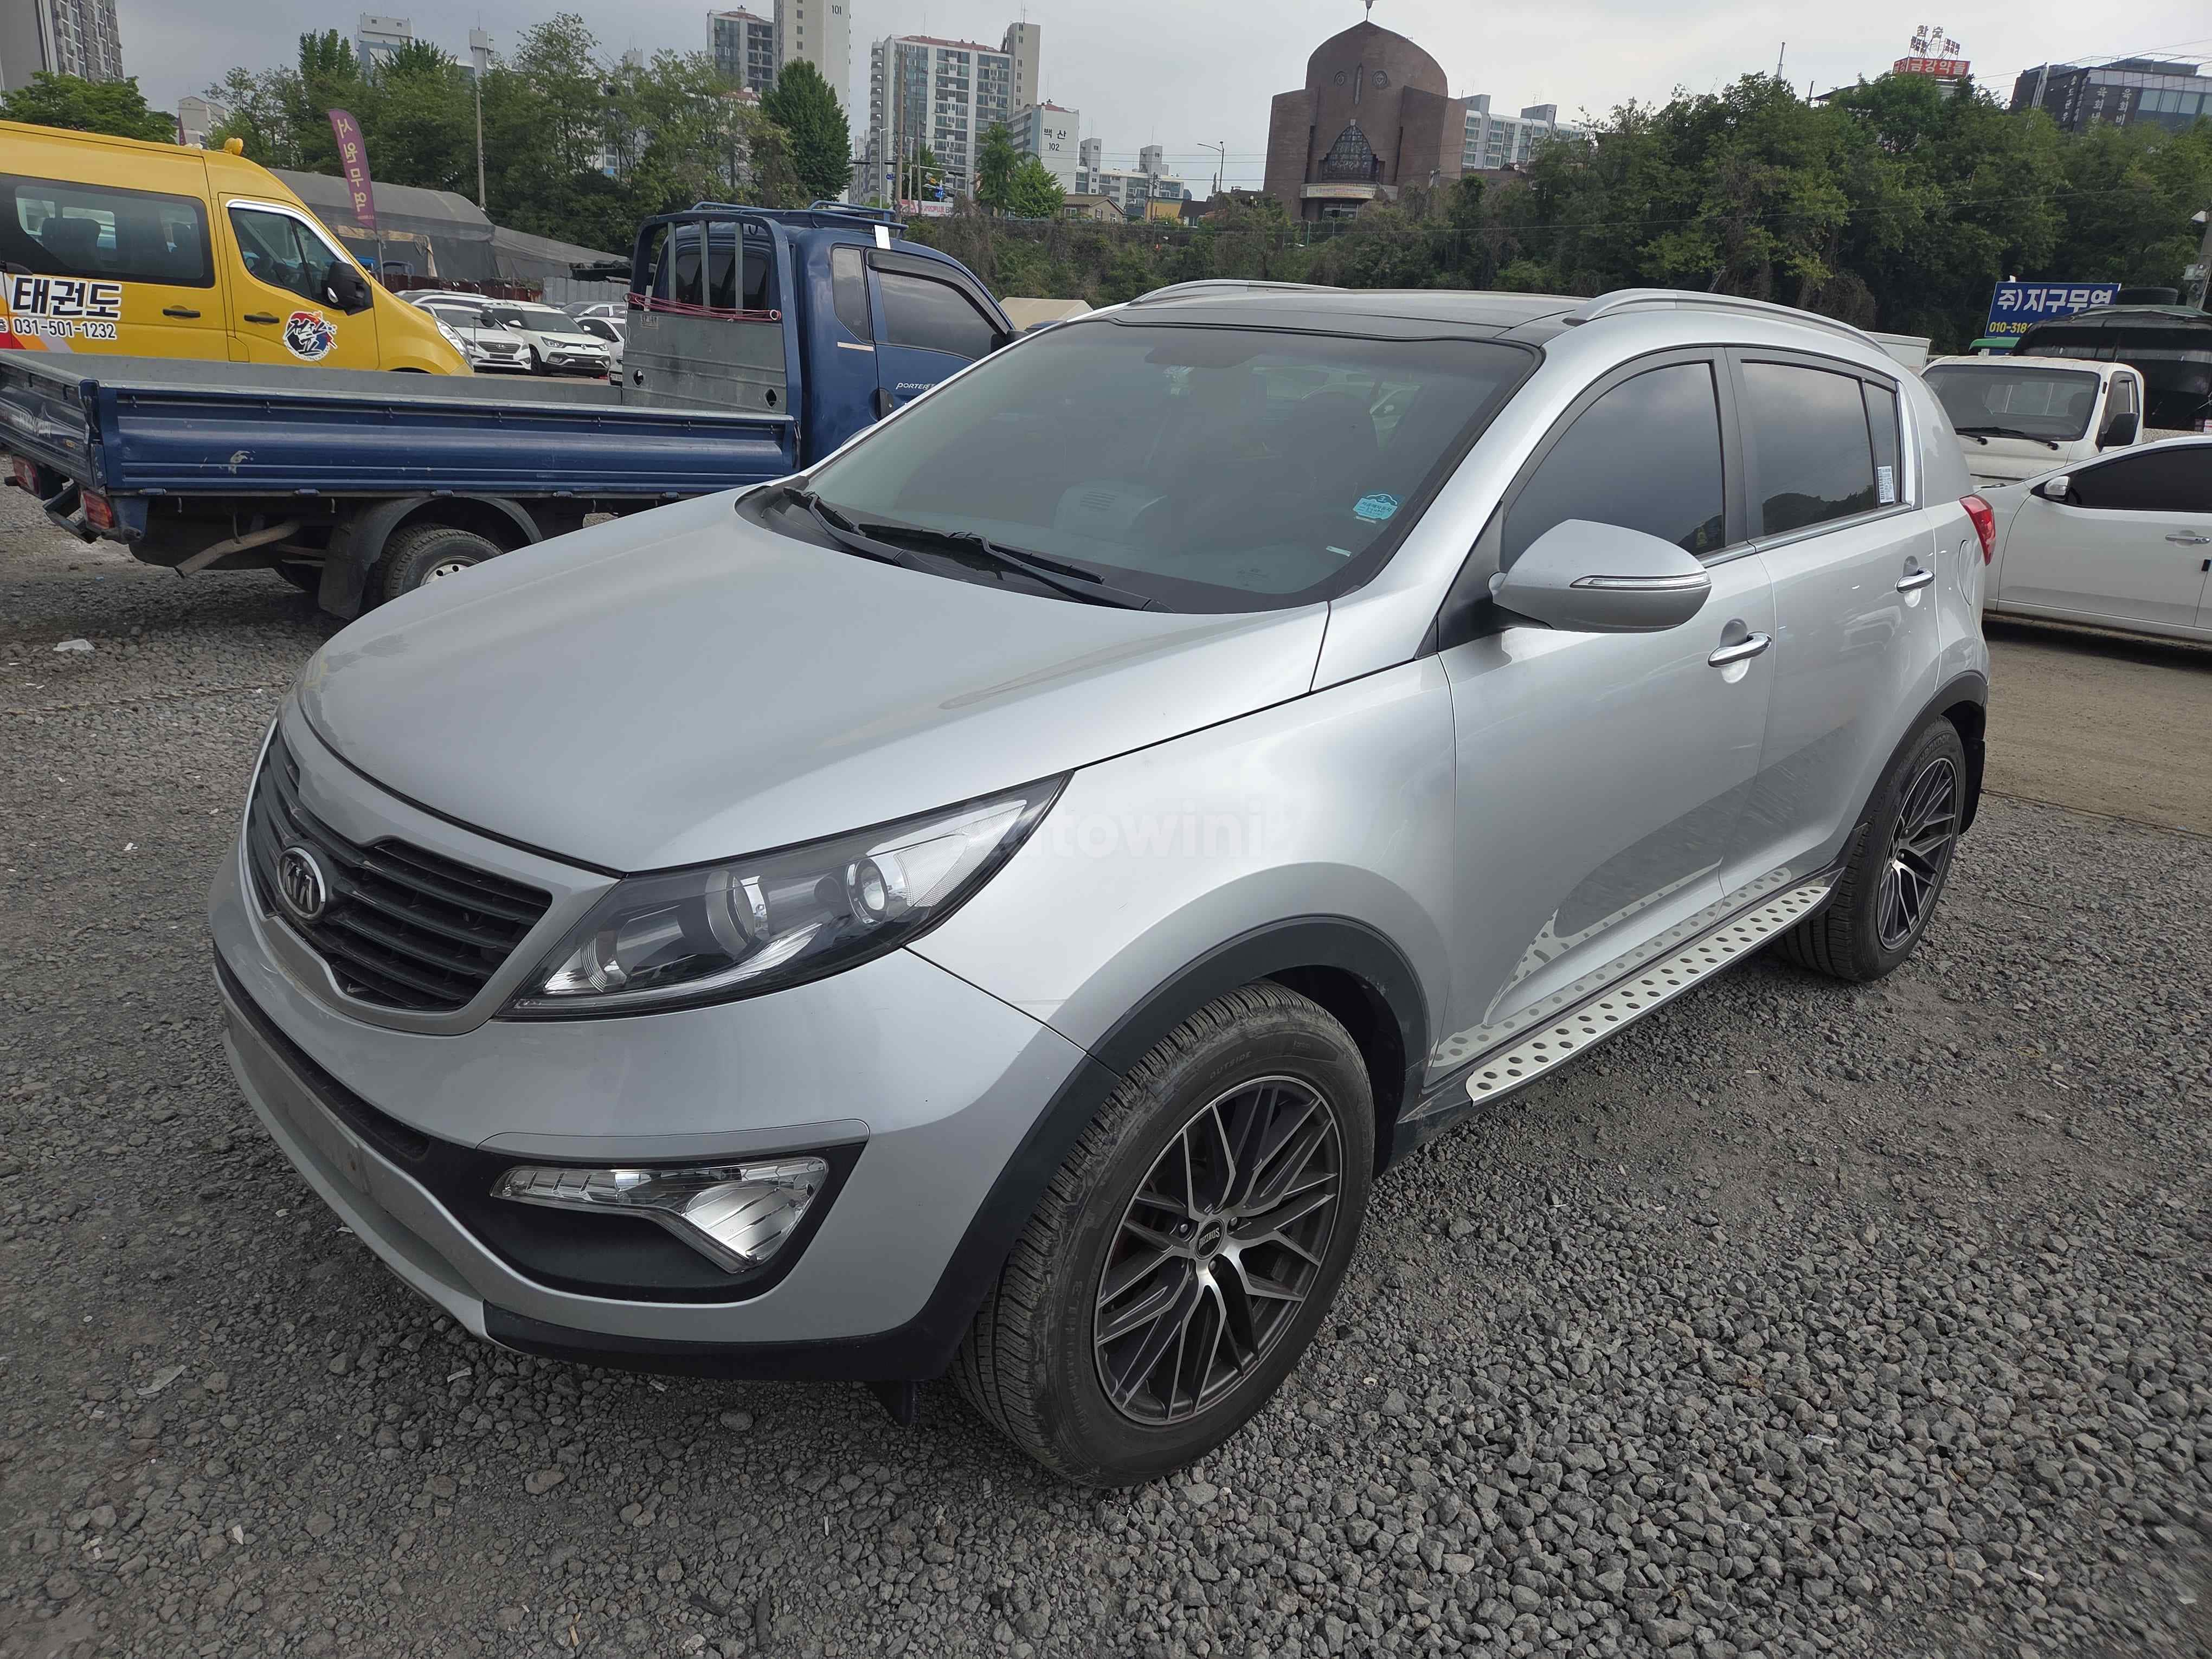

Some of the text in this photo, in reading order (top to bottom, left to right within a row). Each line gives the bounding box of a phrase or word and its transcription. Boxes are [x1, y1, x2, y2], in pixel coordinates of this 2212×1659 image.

[832, 4, 841, 15] 101
[1049, 142, 1060, 151] 102
[12, 276, 120, 318] 태권도
[14, 318, 115, 338] 031-501-1232
[1989, 322, 2033, 333] 010-318
[896, 382, 929, 390] PORTER
[1210, 1050, 1252, 1079] OUTSIDE
